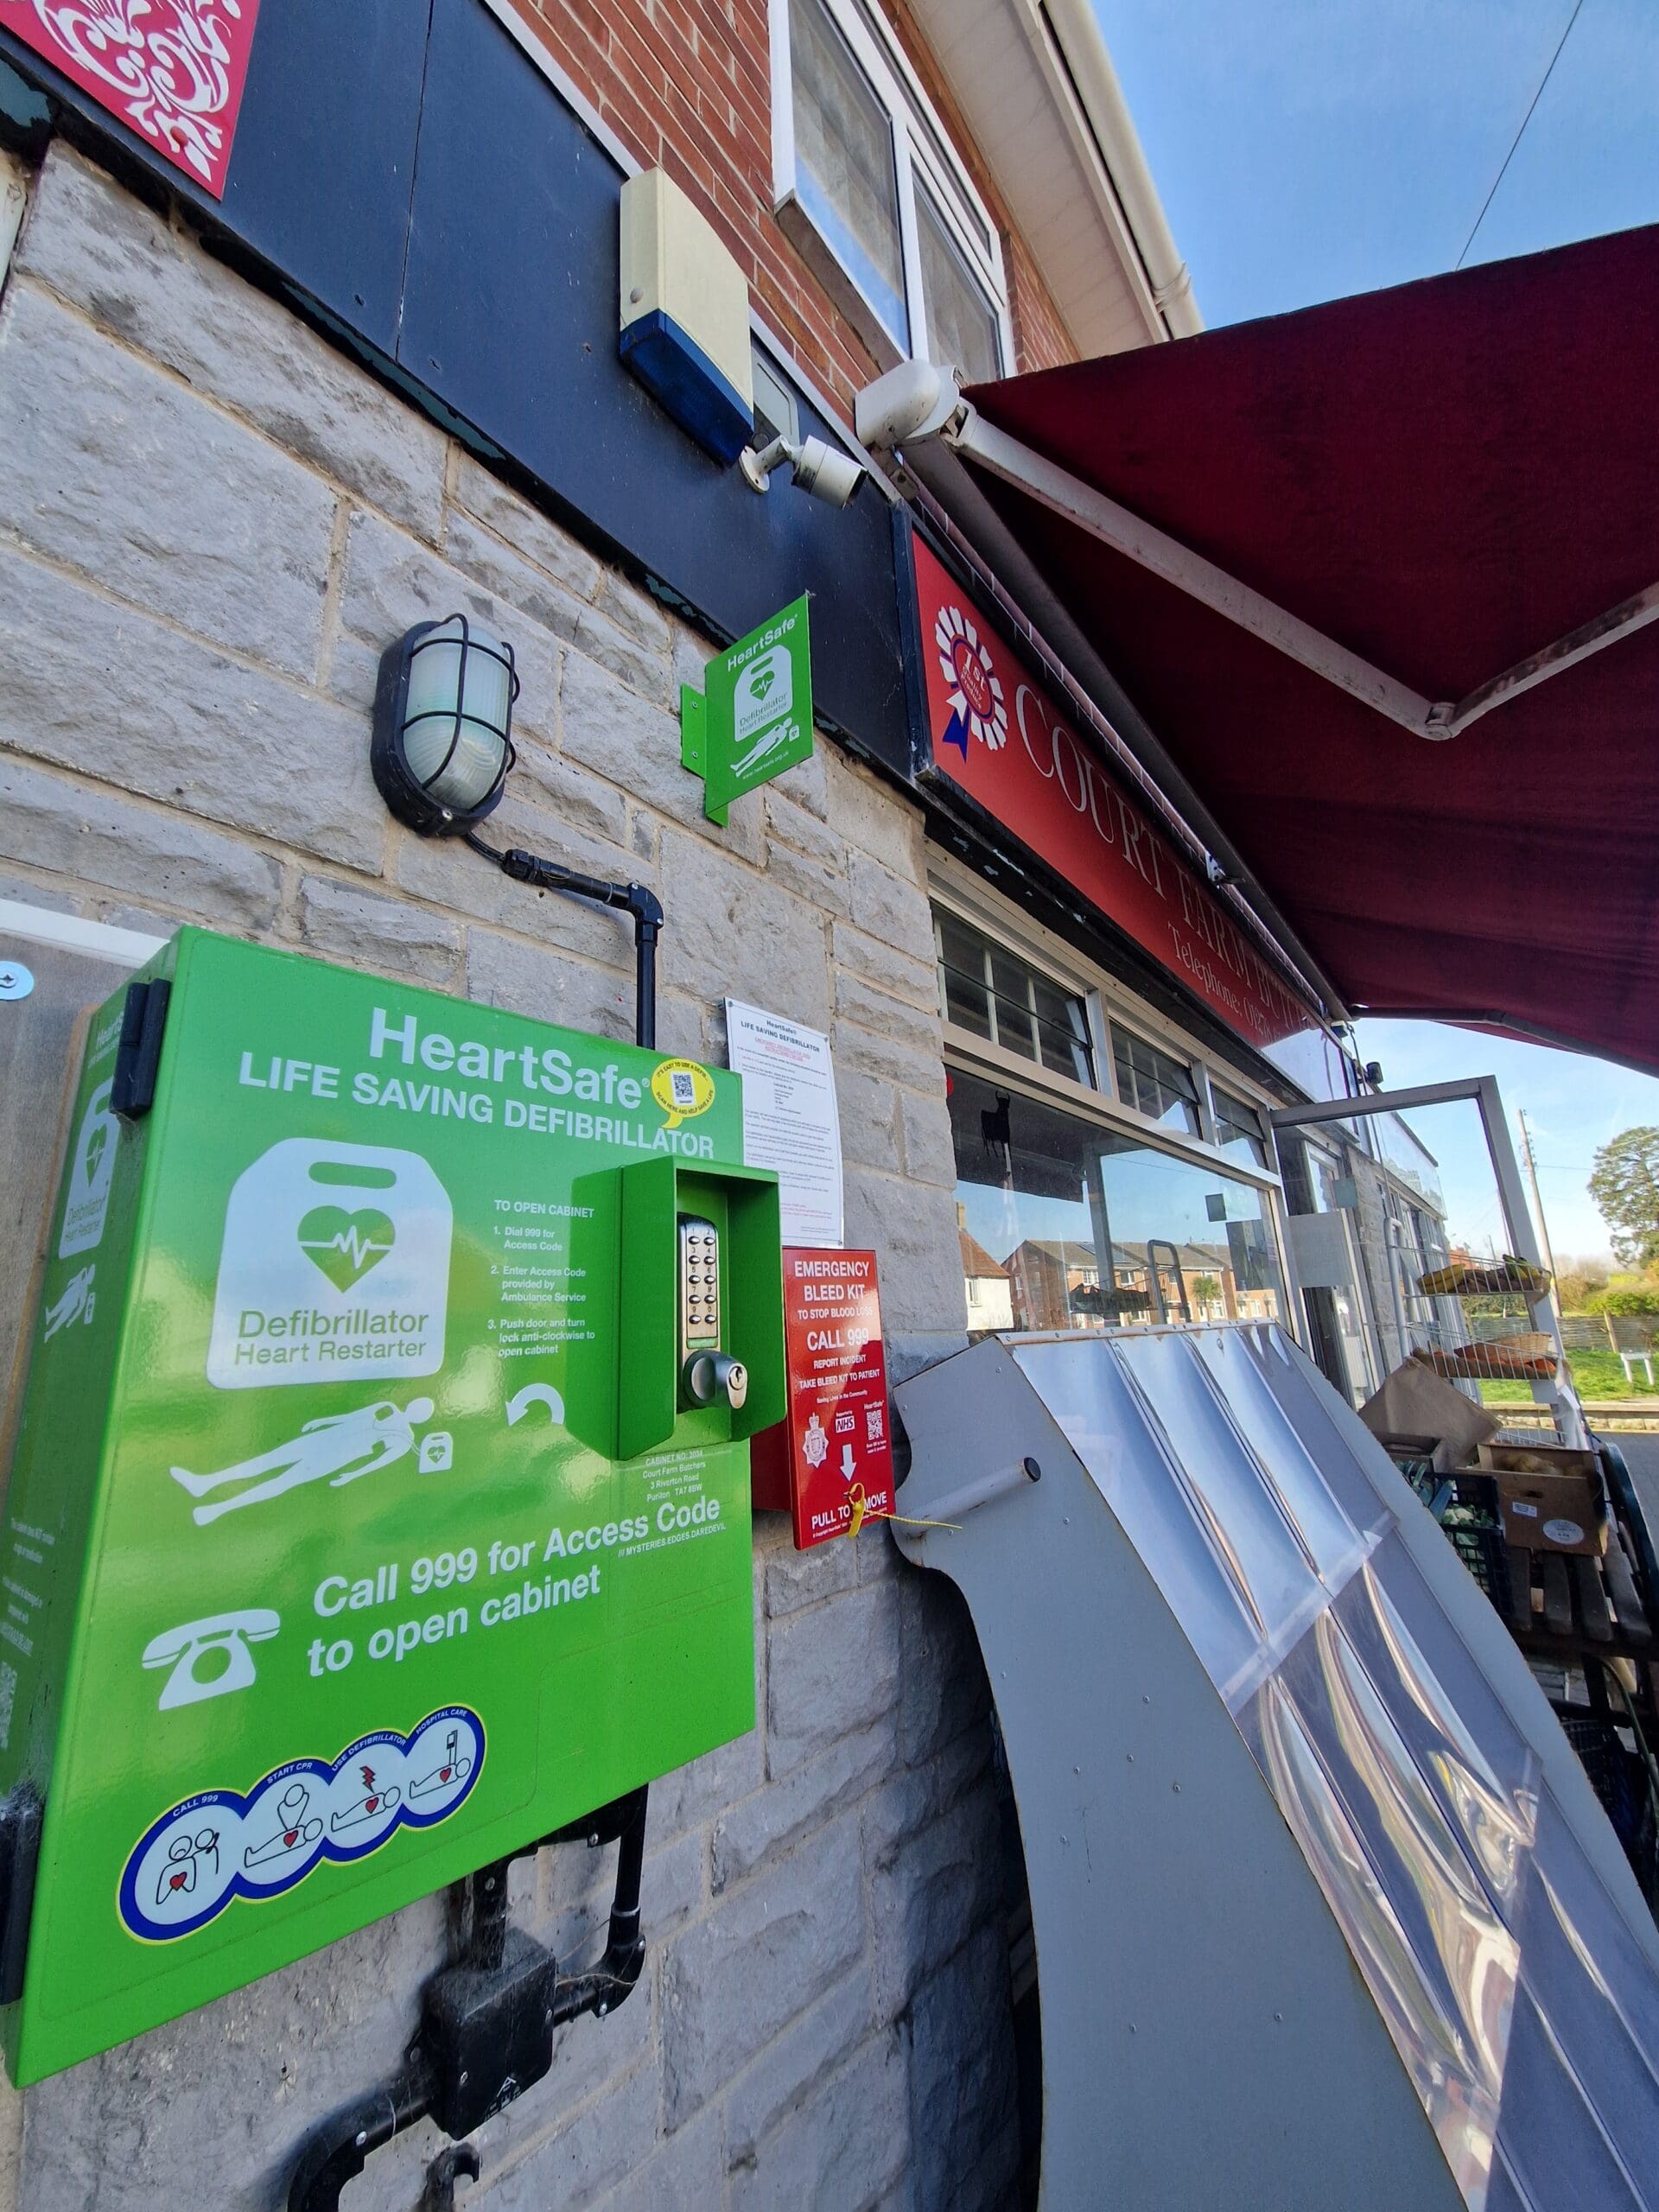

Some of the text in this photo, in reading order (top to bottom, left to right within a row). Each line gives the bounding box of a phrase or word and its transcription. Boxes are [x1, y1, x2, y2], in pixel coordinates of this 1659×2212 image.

[740, 694, 787, 727] Defibrillator
[1016, 684, 1166, 900] COURT
[1174, 863, 1252, 989] FARM
[741, 1020, 754, 1031] LIFE
[756, 1026, 778, 1038] SAVING
[779, 1033, 820, 1052] DEFIBRILLATOR
[239, 1052, 340, 1099] LIFE
[353, 1073, 493, 1123] SAVING
[505, 1099, 715, 1159] DEFIBRILLATOR
[494, 1199, 594, 1218] TO OPEN CABINET
[493, 1226, 556, 1238] 1. Dial 999 for
[504, 1240, 563, 1251] Access Code
[491, 1265, 586, 1277] 2. Enter Access Code
[794, 1261, 869, 1277] EMERGENCY
[502, 1280, 555, 1291] provided by
[804, 1285, 865, 1301] BLEED KIT
[501, 1292, 586, 1302] Ambulance Service
[798, 1306, 873, 1319] TO STOP BLOOD LOSS
[238, 1309, 429, 1338] Defibrillator
[488, 1318, 585, 1330] 3. Push door and turn
[499, 1331, 594, 1344] lock anti-clockwise to
[807, 1328, 869, 1351] CALL 999
[234, 1339, 427, 1365] Heart Restarter
[498, 1344, 558, 1357] open cabinet
[813, 1354, 867, 1370] REPORT INCIDENT
[799, 1369, 880, 1389] TAKE BLEED KIT TO PATIENT
[836, 1417, 854, 1431] NHS
[645, 1453, 676, 1466] CABINET
[643, 1461, 706, 1479] Court Farm Butchers
[650, 1473, 699, 1490] 3 Riverton Road
[675, 1487, 687, 1497] TA7
[811, 1510, 836, 1530] PULL
[838, 1504, 850, 1520] TO
[864, 1491, 887, 1510] MOVE
[314, 1496, 720, 1618] Call 999 for Access Code
[308, 1565, 601, 1677] to open cabinet
[416, 1707, 468, 1734] HOSPITAL CARE
[332, 1733, 407, 1772] USE DEFIBRILLATOR
[267, 1762, 313, 1783] START CPR
[173, 1795, 219, 1817] CALL 999
